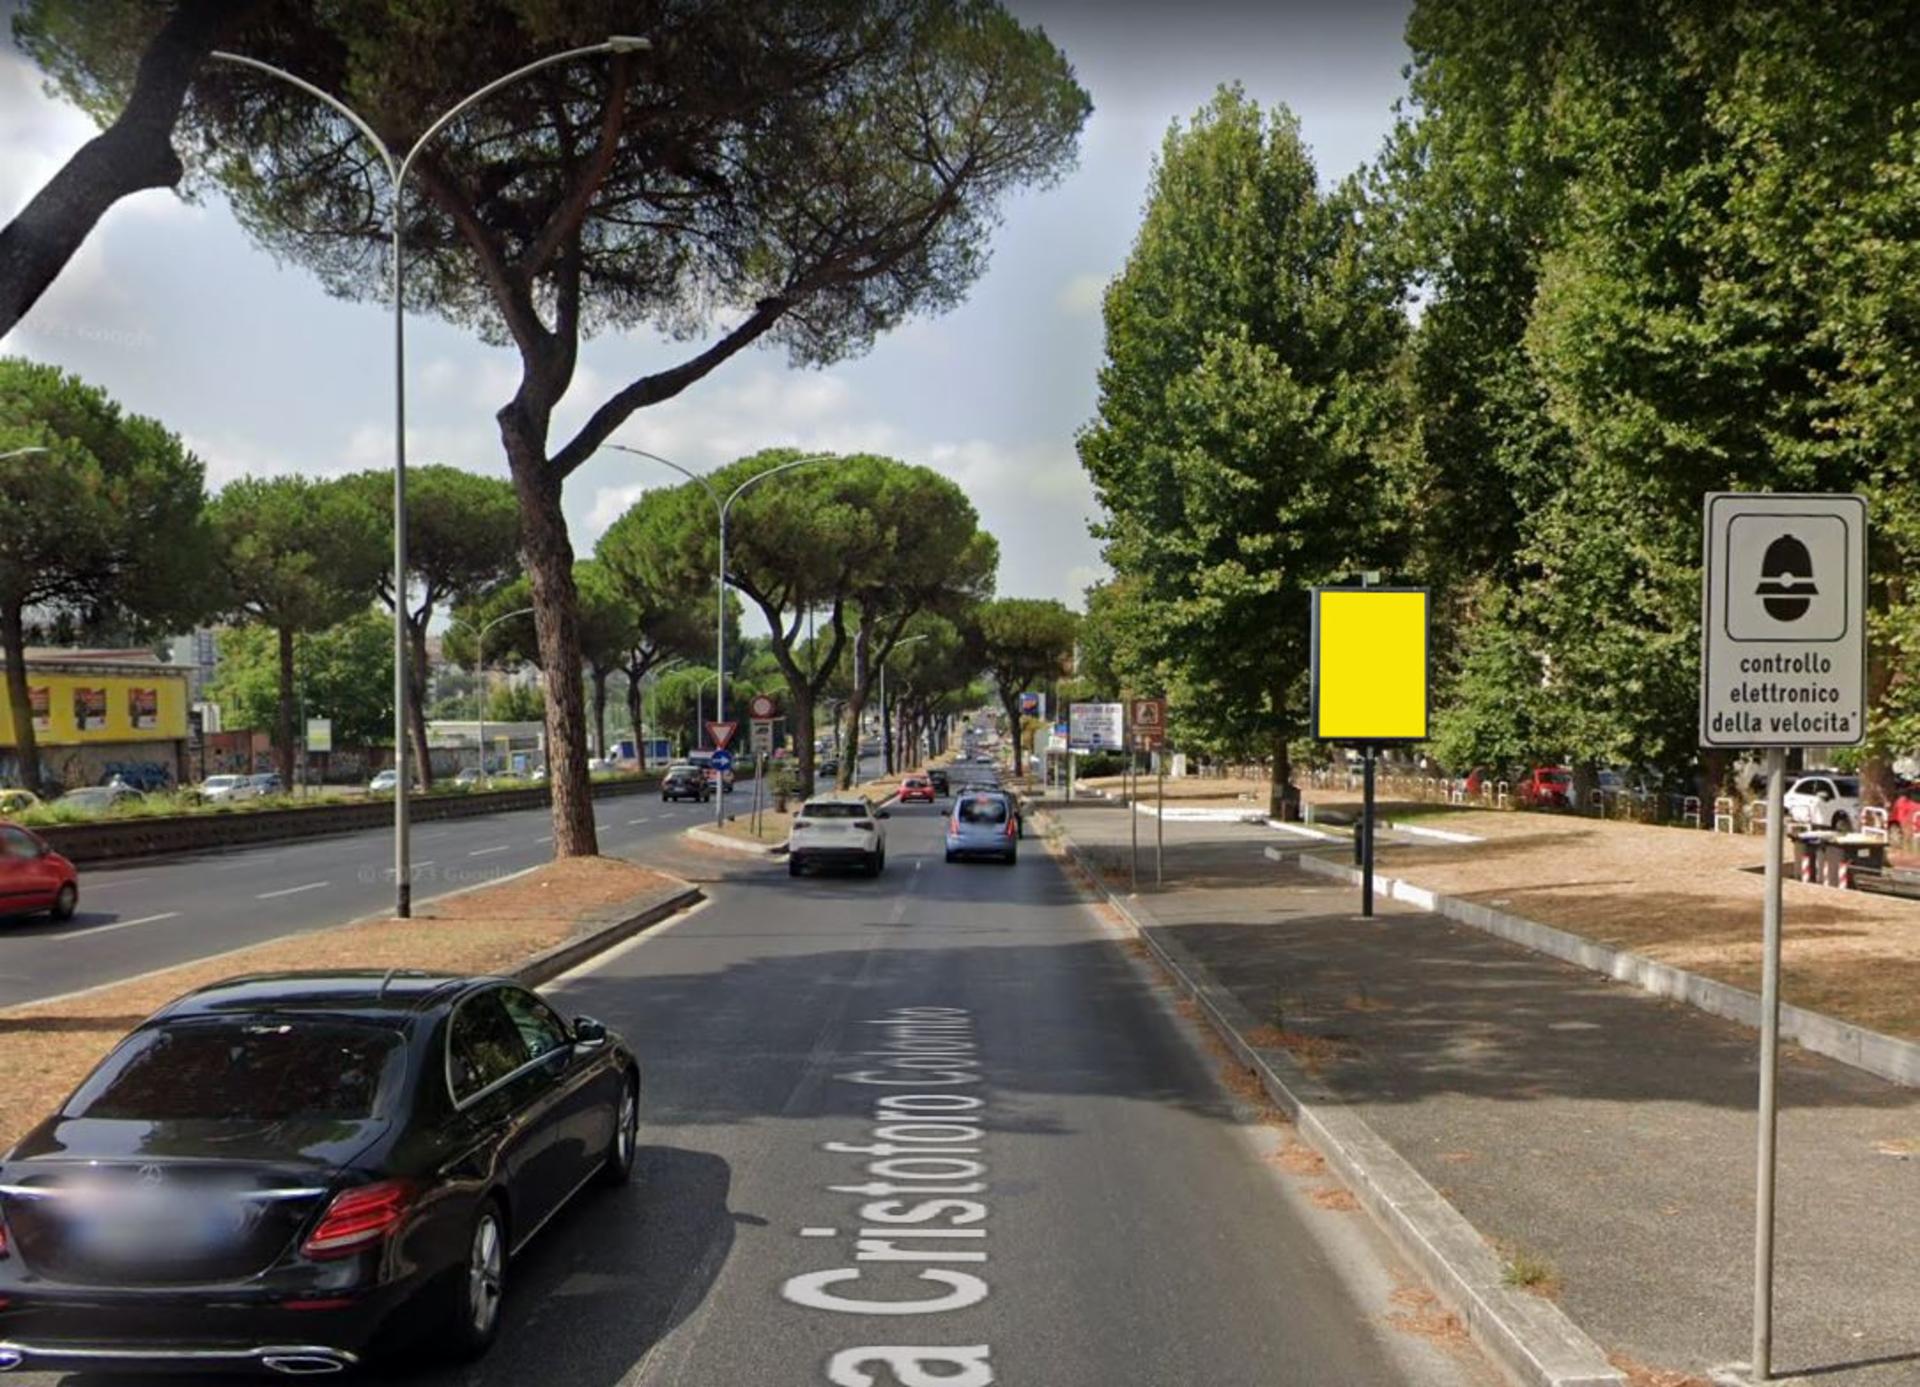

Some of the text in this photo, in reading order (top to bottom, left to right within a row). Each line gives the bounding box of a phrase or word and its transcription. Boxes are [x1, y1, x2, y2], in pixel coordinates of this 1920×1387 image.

[1740, 652, 1831, 674] controllo
[1730, 682, 1839, 704] elettronico
[1712, 711, 1762, 733] della
